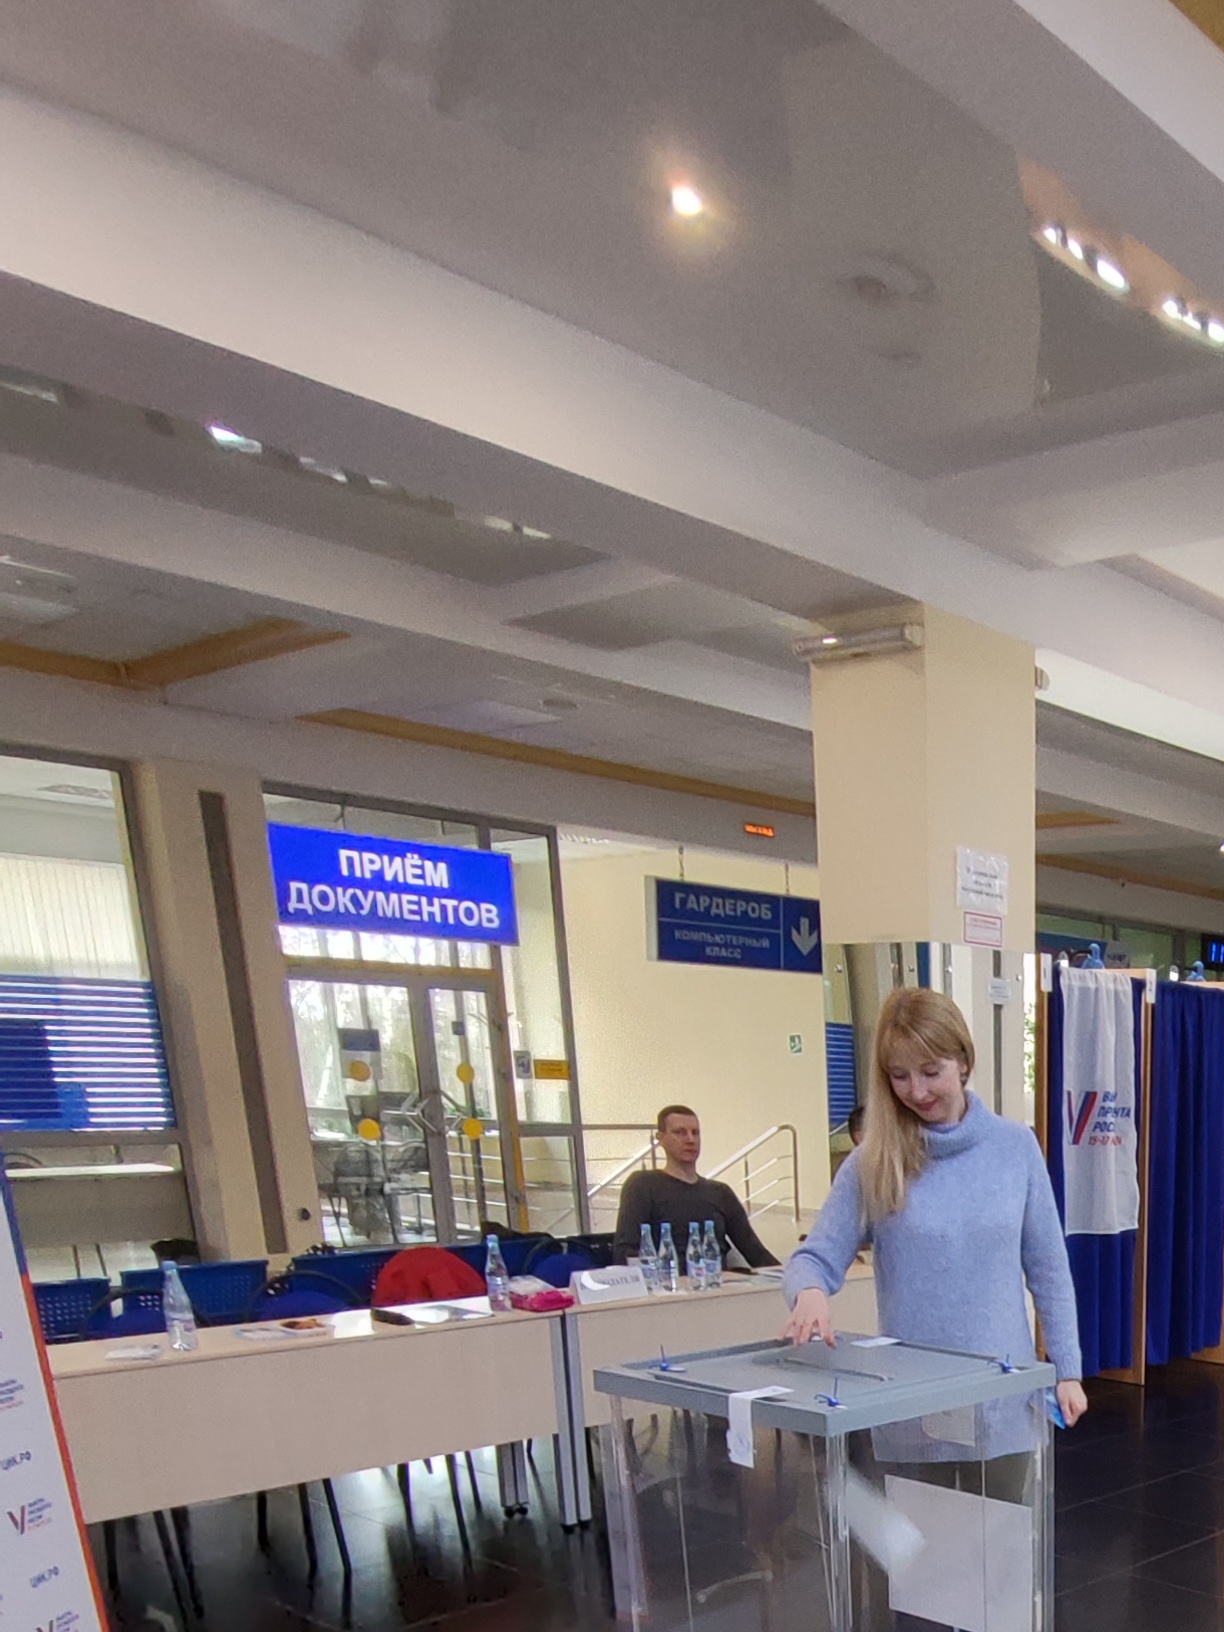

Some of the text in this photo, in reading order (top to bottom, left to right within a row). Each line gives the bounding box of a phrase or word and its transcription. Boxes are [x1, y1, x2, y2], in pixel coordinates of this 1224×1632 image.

[338, 848, 449, 889] ПРИЁМ
[287, 881, 500, 929] ДОКУМЕНТОВ
[674, 891, 772, 920] ГАРДЕРОБ
[674, 929, 770, 949] КОМПЬЮТЕРНЫЙ
[705, 946, 742, 959] КЛАСС
